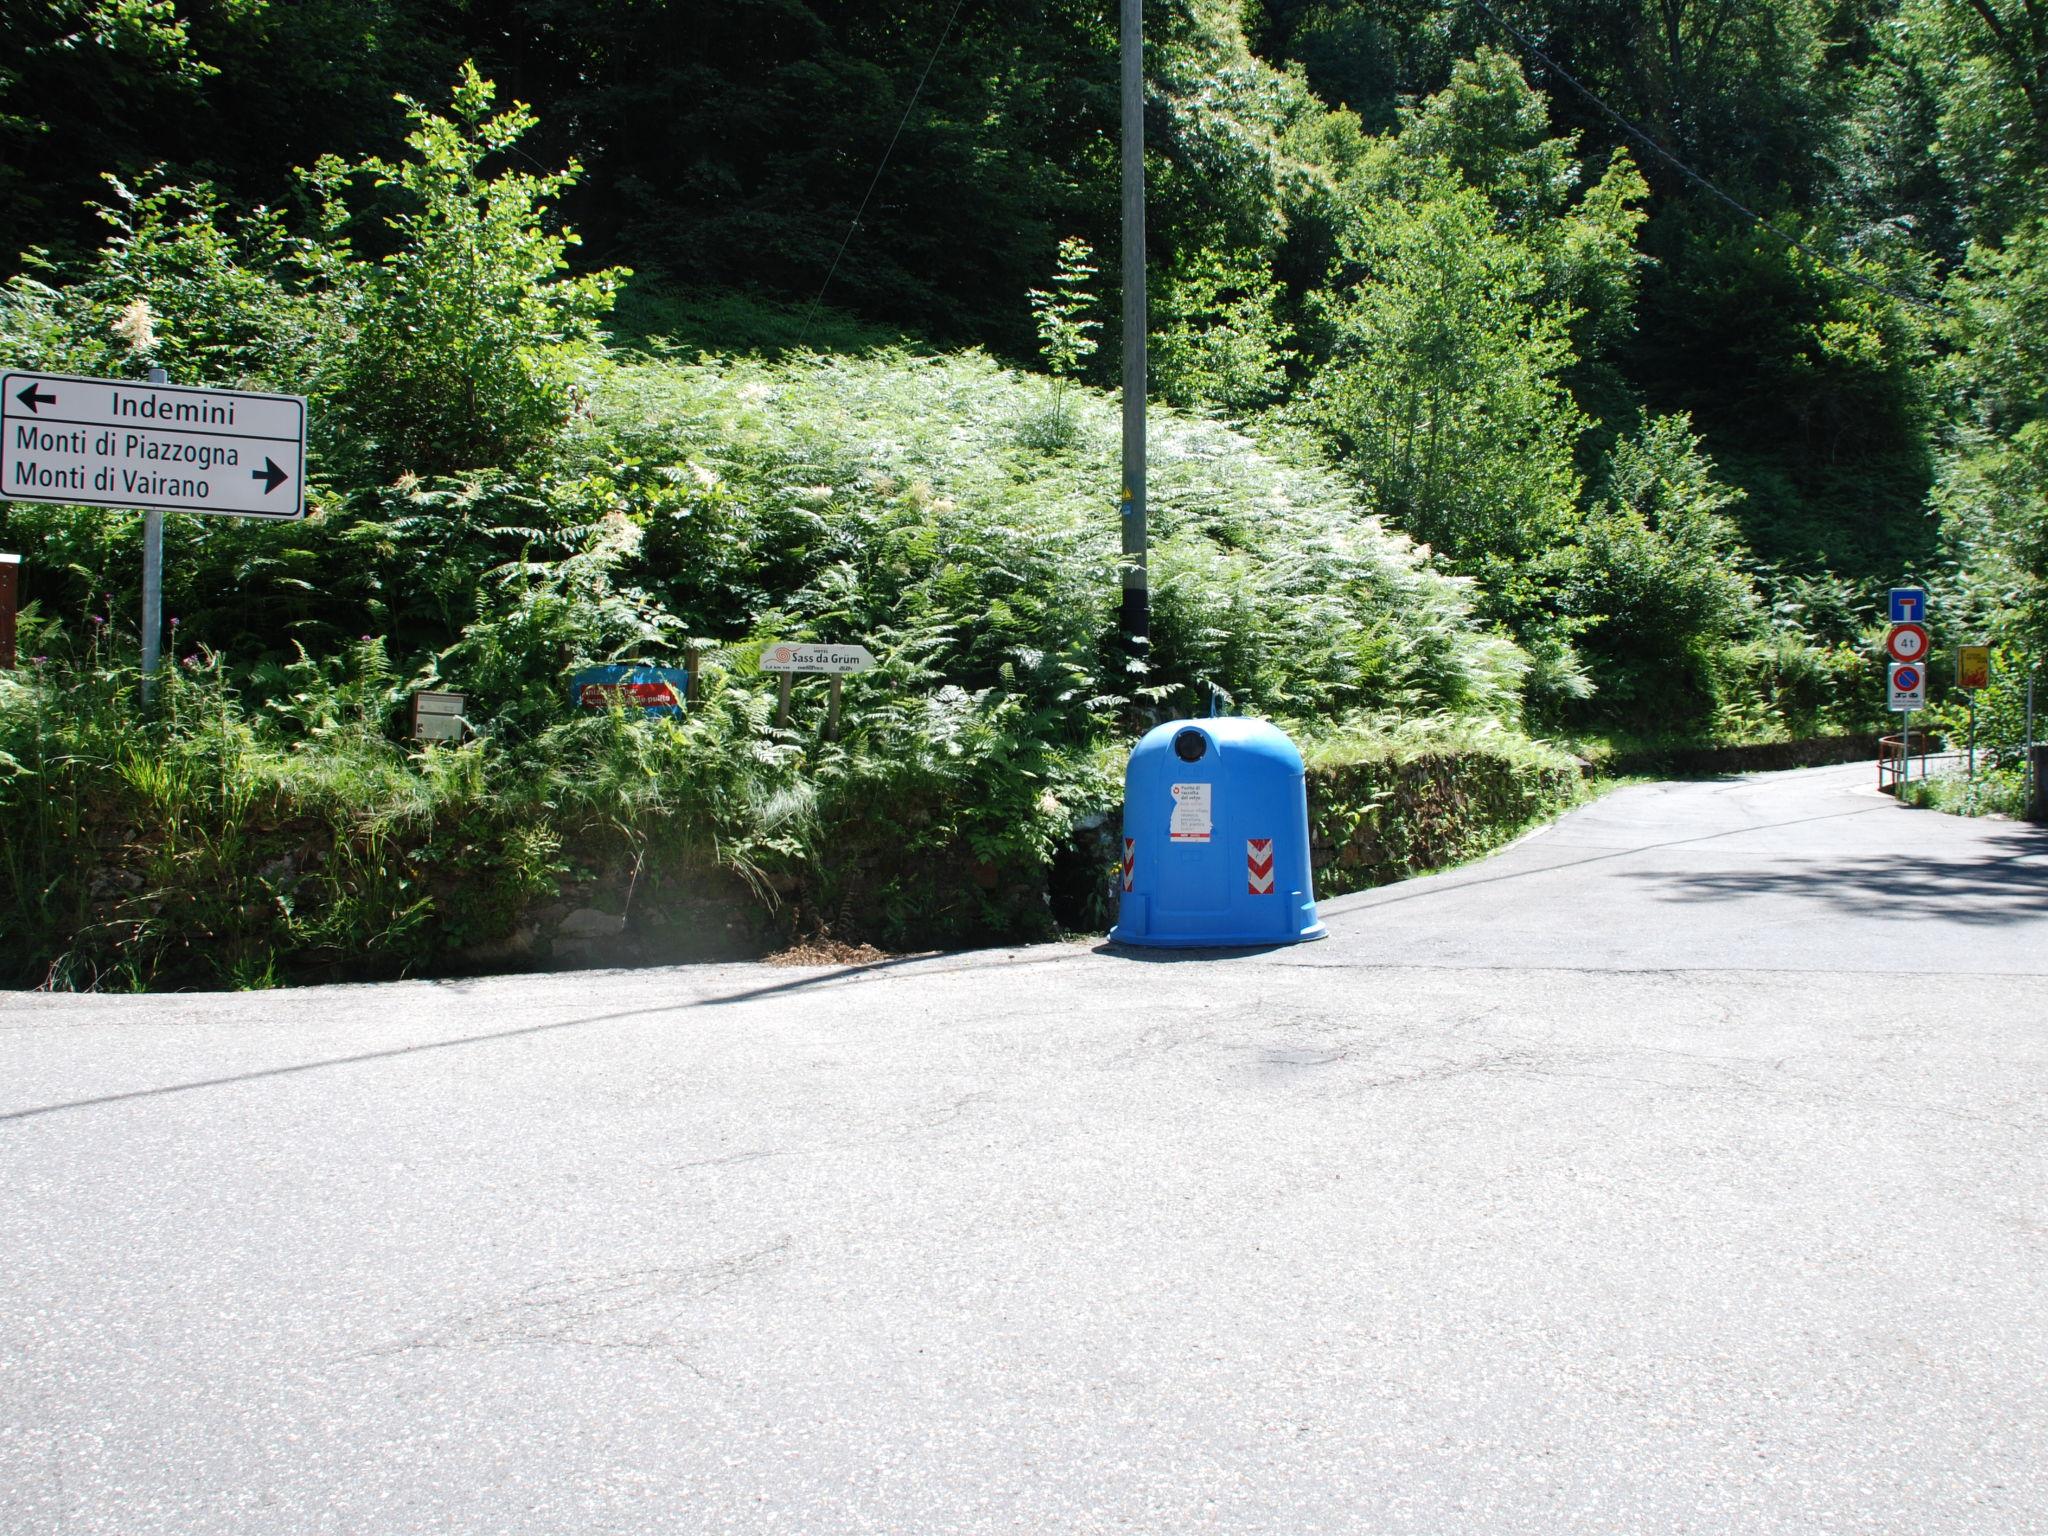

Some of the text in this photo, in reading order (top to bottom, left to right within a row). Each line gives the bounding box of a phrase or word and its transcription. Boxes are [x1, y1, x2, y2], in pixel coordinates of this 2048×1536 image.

[113, 392, 235, 425] Indemini
[17, 425, 239, 470] Monti di Piazzogna
[16, 461, 209, 498] Monti di Vairano
[792, 653, 860, 664] Sass da Grüm
[1901, 639, 1914, 648] 4 t
